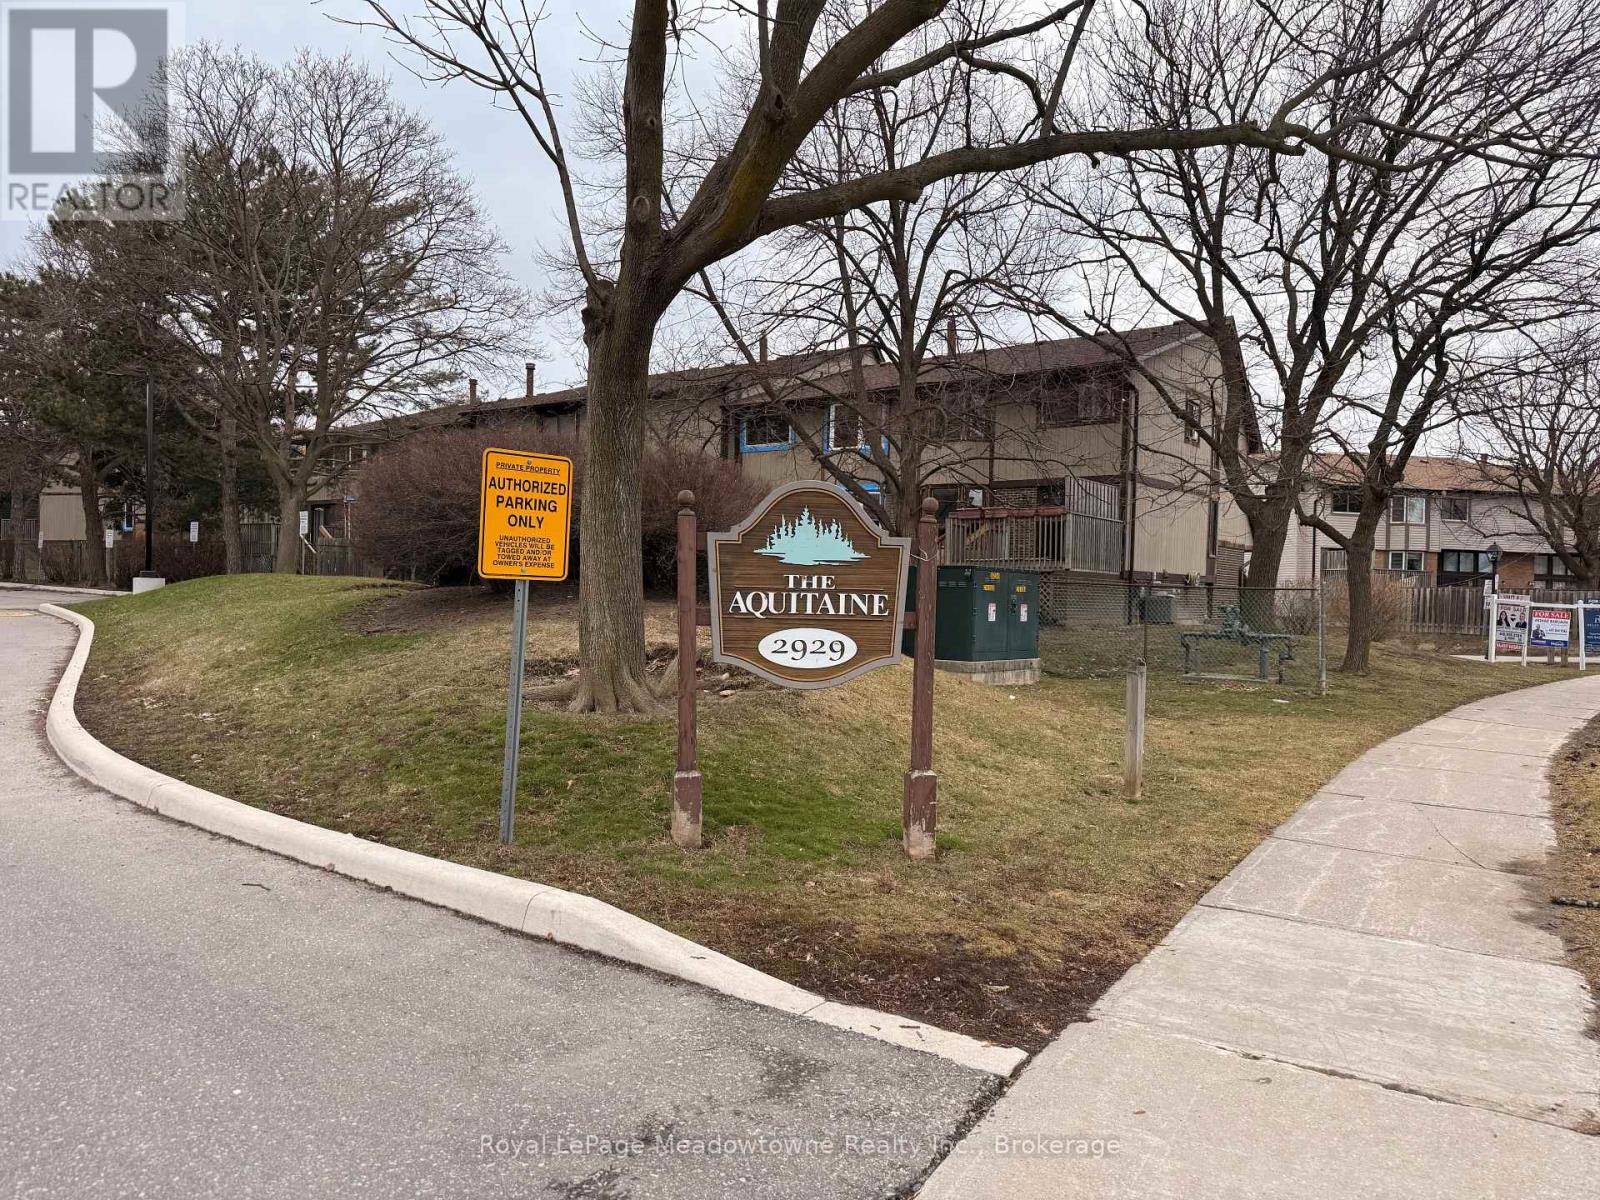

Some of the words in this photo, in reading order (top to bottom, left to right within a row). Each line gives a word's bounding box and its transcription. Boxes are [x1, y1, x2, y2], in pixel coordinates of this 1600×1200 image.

[496, 461, 524, 471] PRIVATE
[525, 465, 561, 474] PROPERTY
[488, 476, 567, 496] AUTHORIZED
[496, 495, 558, 512] PARKING
[507, 514, 545, 529] ONLY
[495, 540, 528, 549] VEHICLES
[499, 534, 551, 544] UNAUTHORIZED
[497, 547, 525, 555] TAGGED
[497, 553, 521, 561] TOWED
[524, 561, 555, 569] EXPENSE
[784, 574, 836, 590] THE
[728, 591, 889, 619] AQUITAINE
[771, 639, 846, 662] 2929
